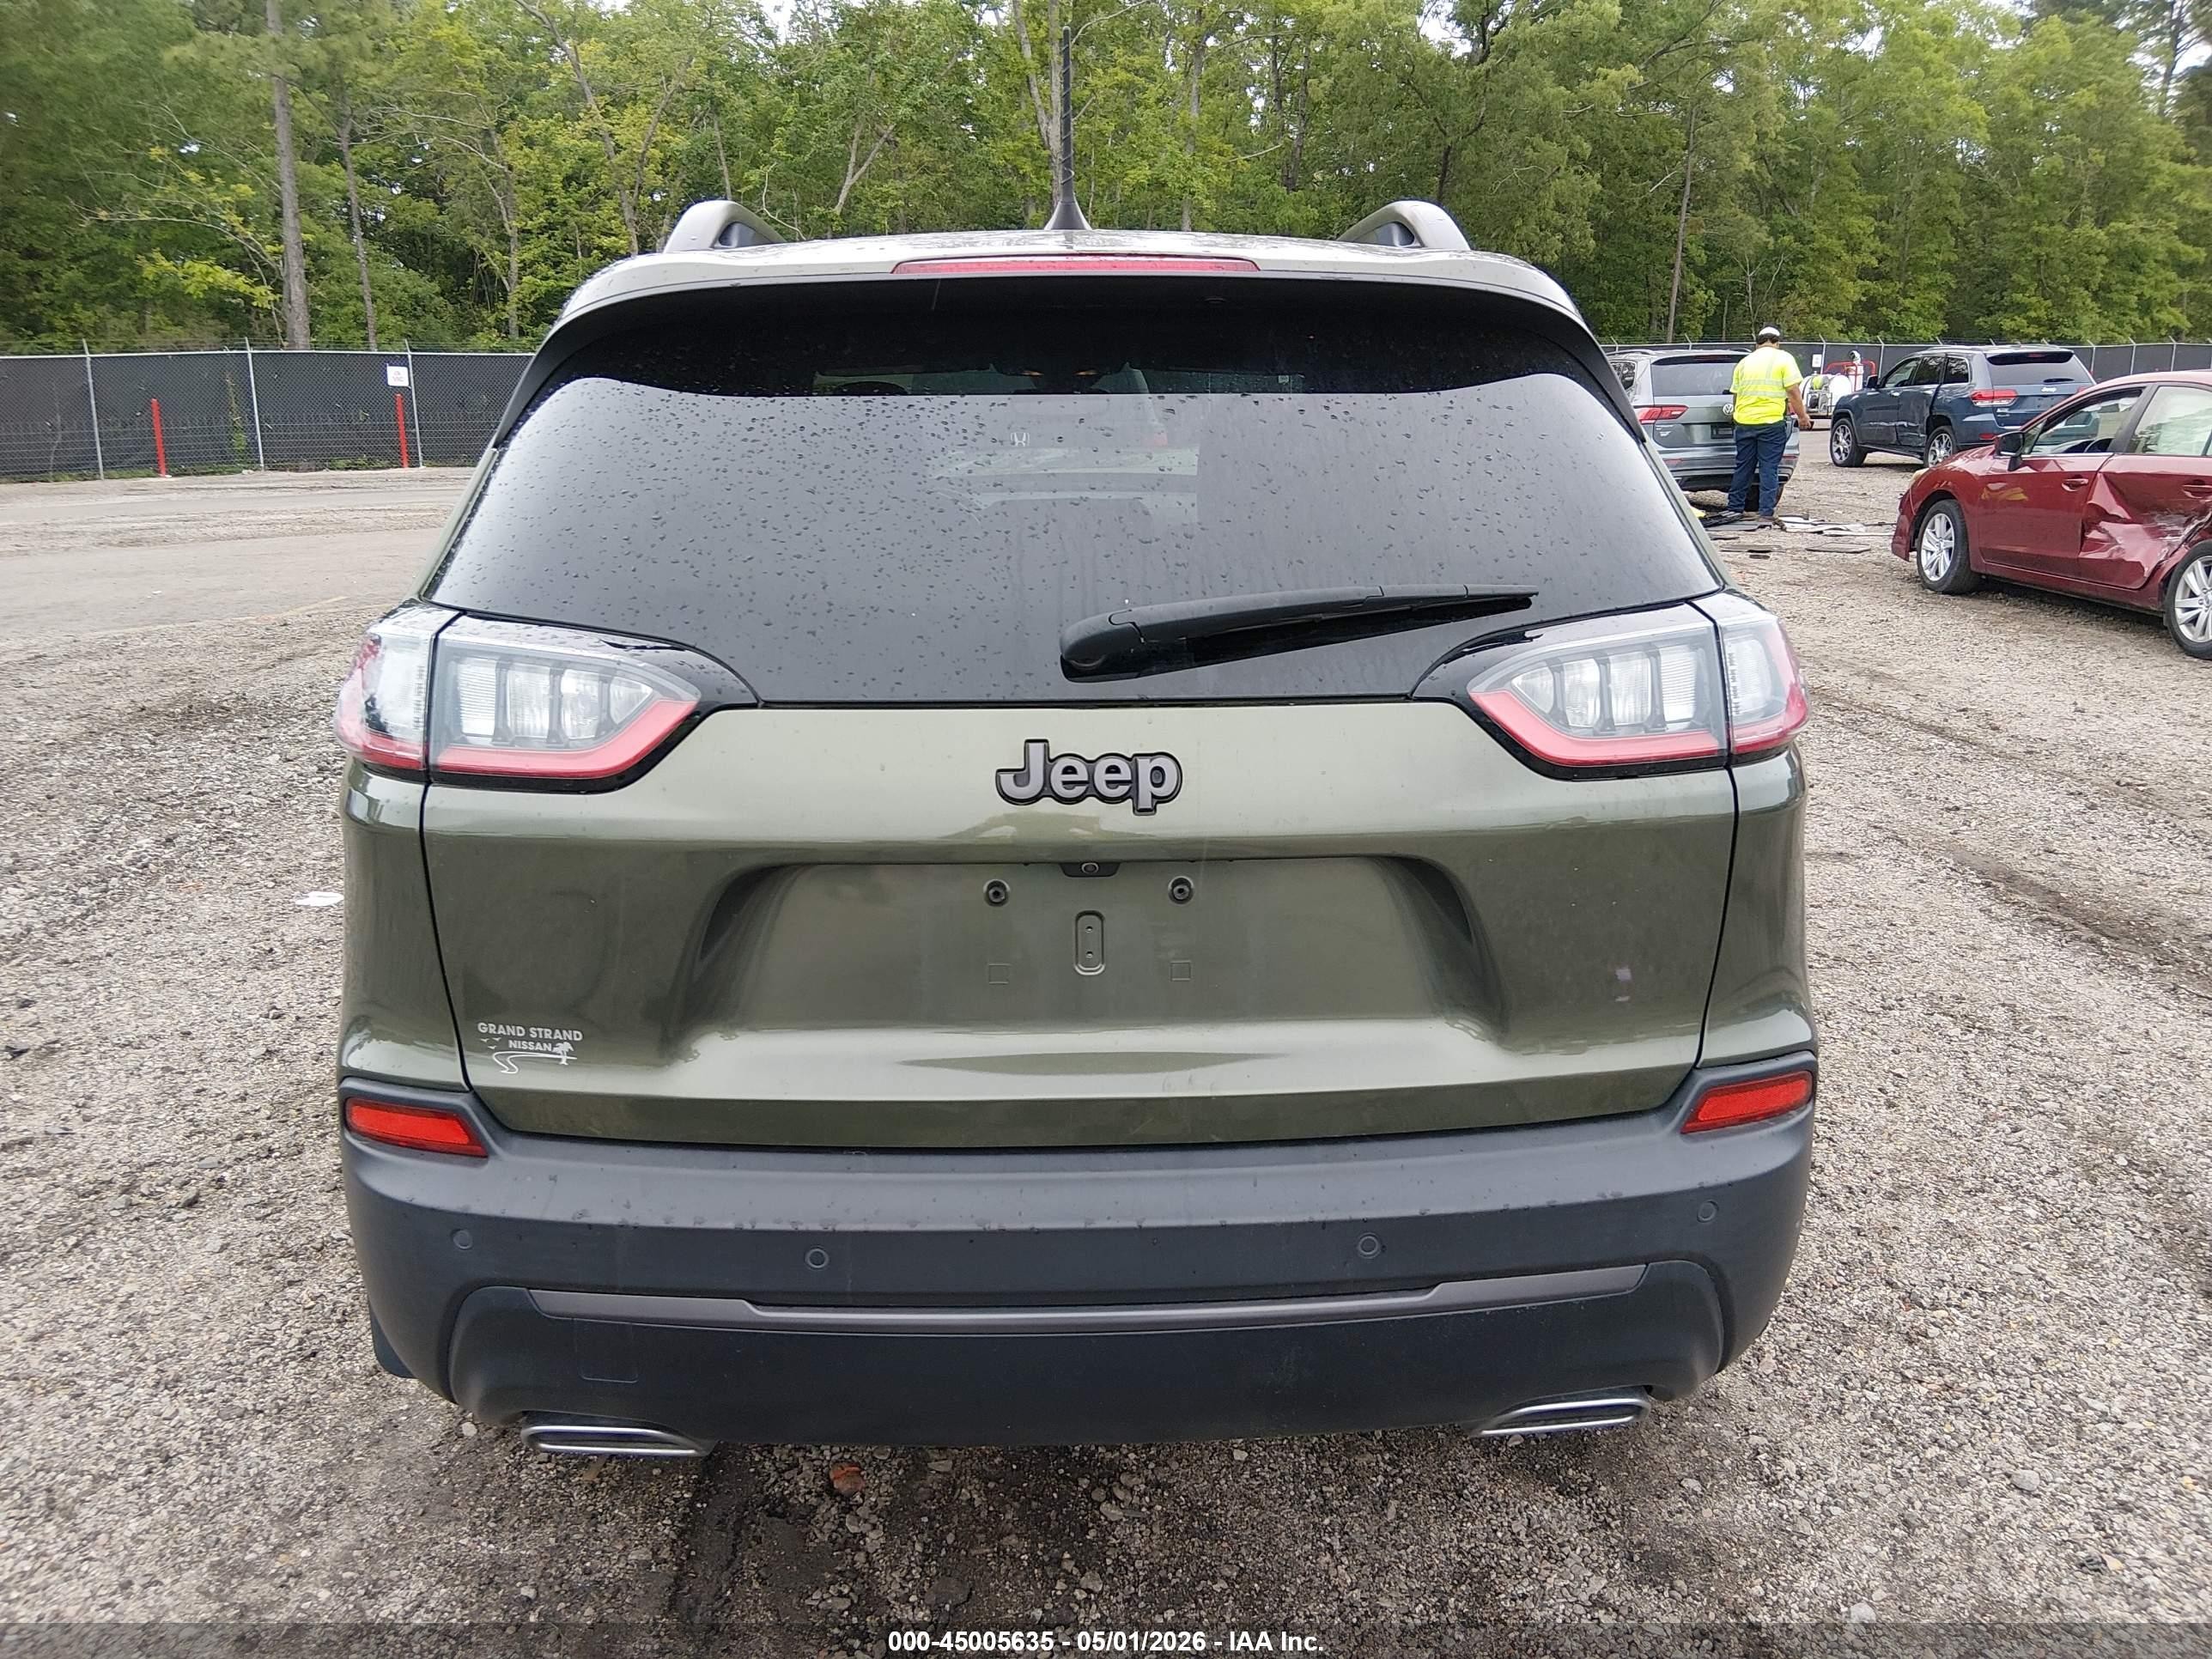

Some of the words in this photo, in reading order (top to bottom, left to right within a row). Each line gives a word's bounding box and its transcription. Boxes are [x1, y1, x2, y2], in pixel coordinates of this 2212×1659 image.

[995, 739, 1182, 815] Jeep
[477, 1022, 526, 1037] GRAND
[529, 1027, 583, 1042] STRAND
[508, 1040, 552, 1052] NISSAN
